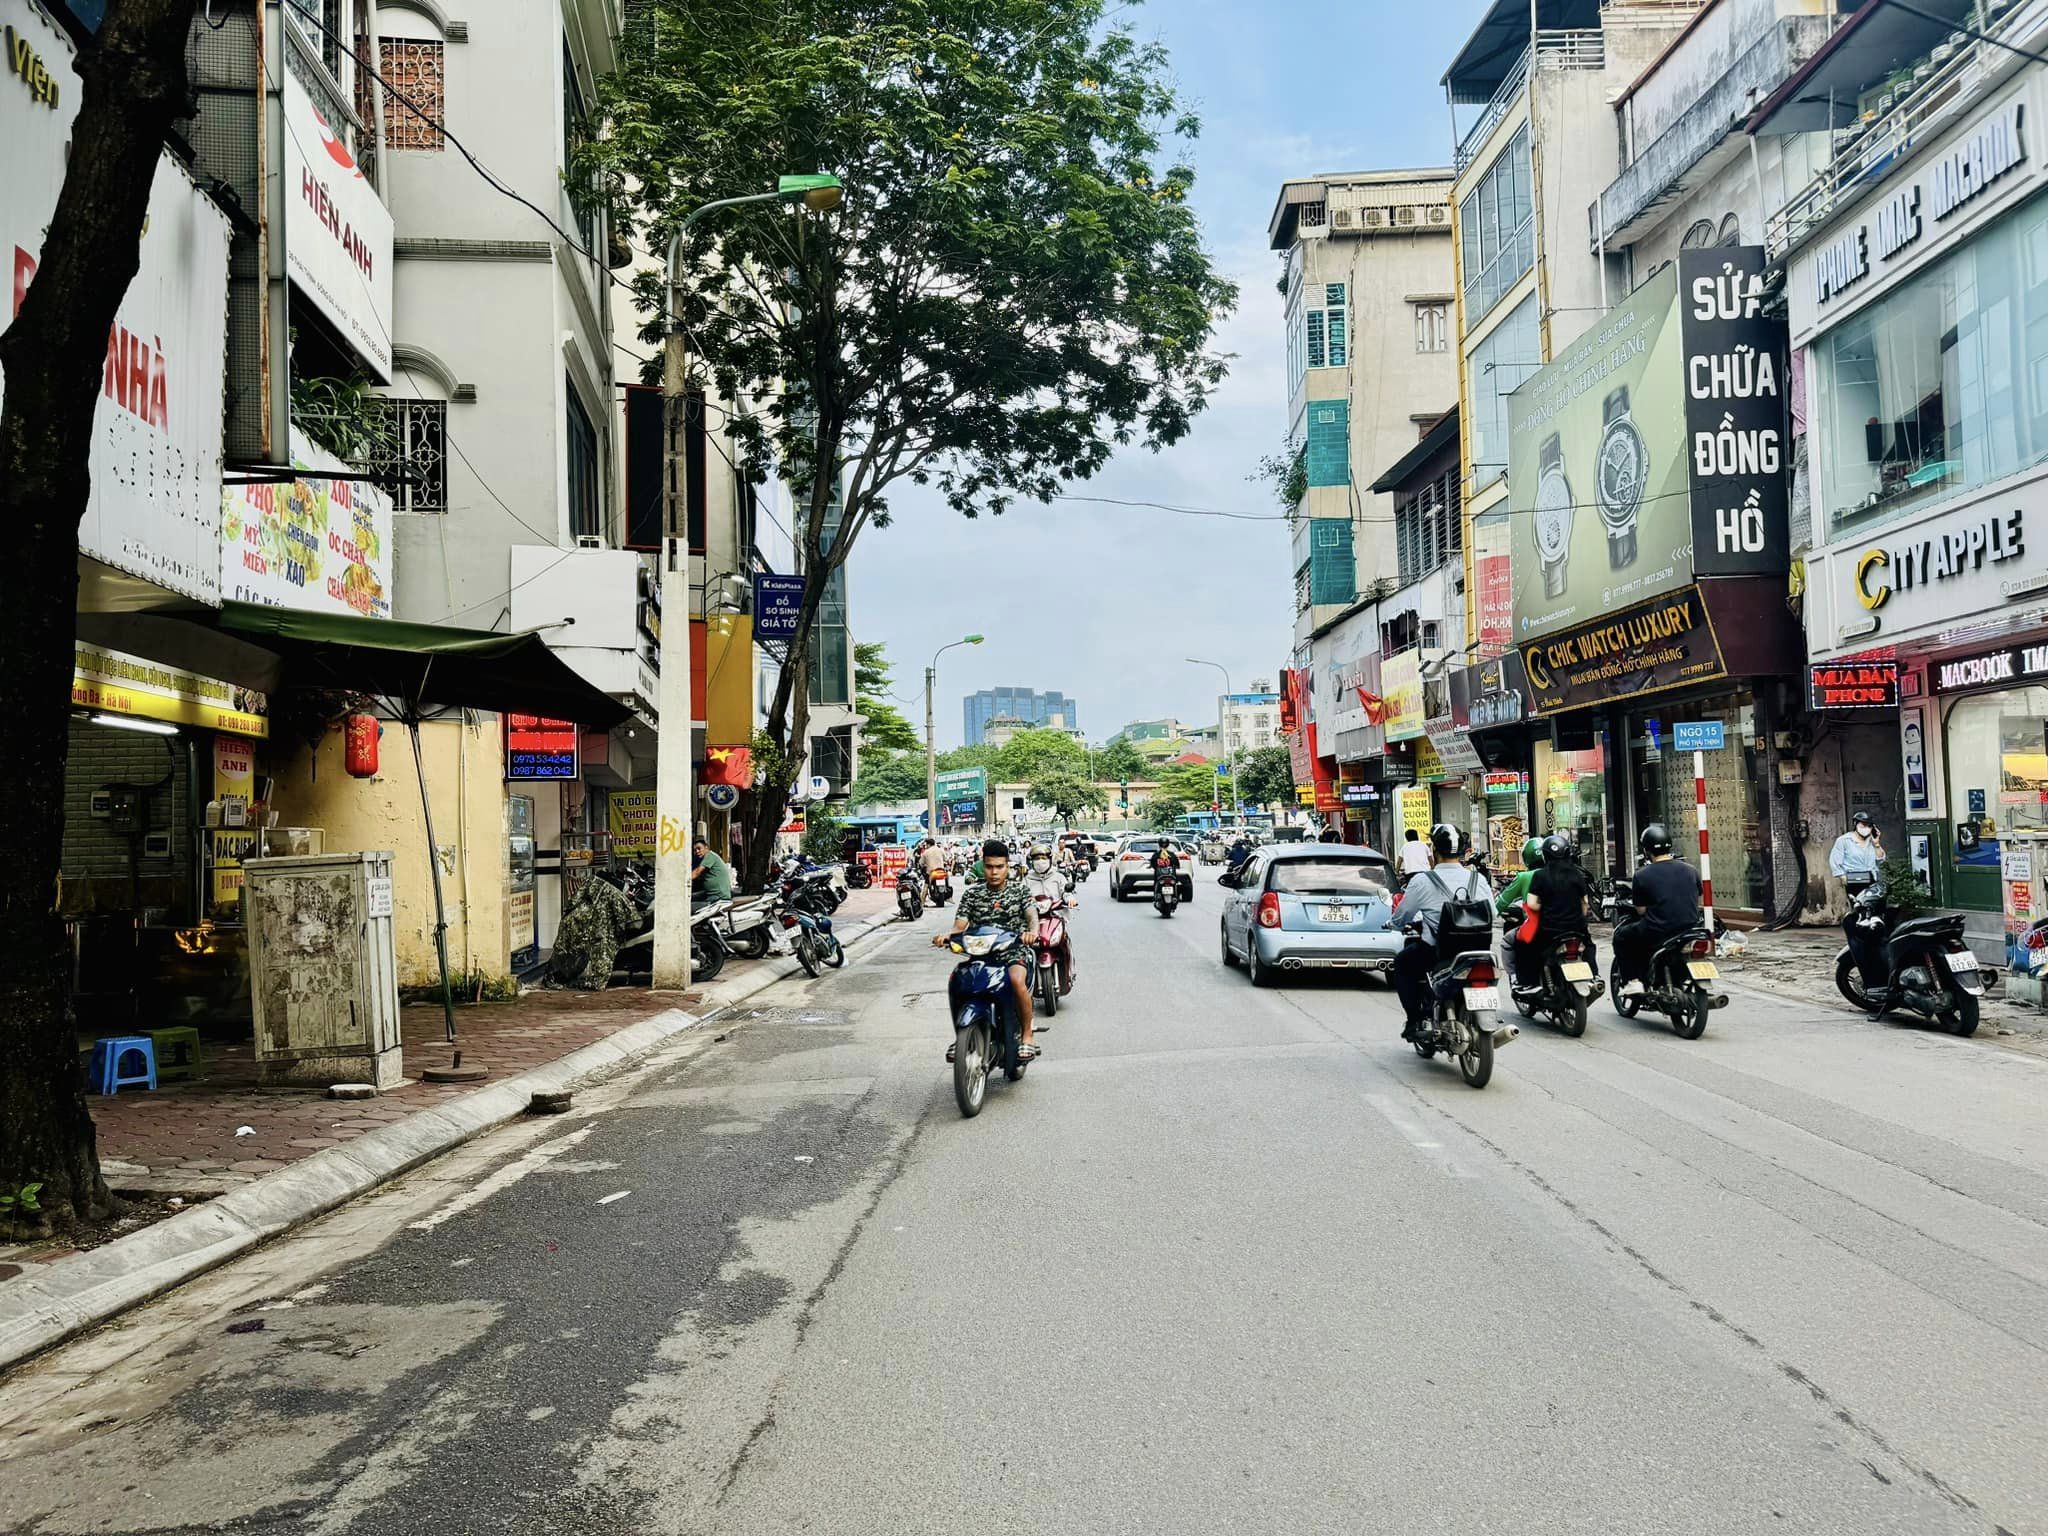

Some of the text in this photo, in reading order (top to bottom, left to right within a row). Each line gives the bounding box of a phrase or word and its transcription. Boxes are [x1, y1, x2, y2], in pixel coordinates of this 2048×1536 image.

[1877, 185, 1922, 262] IMAC
[1932, 104, 2028, 222] MACBOOK
[343, 221, 373, 283] ANH
[1692, 262, 1767, 321] SỬA
[104, 319, 169, 436] NHÀ
[1688, 343, 1777, 399] CHỮA
[1694, 411, 1780, 476] ĐỒNG
[1715, 488, 1765, 553] HỒ
[1935, 509, 2025, 579] APPLE
[760, 615, 799, 628] GIÁ TỐ
[765, 606, 800, 615] SƠ SINH
[1547, 601, 1694, 670] CHIC WATCH LUXURY
[1570, 671, 1587, 686] MUA
[1814, 669, 1859, 687] MUA
[1941, 653, 2014, 689] MACBOOK
[72, 683, 88, 702] ống
[1824, 688, 1886, 704] IPHONE
[1705, 727, 1717, 736] 15
[221, 760, 248, 772] ANH
[623, 809, 654, 819] PHOTO
[621, 824, 632, 833] IN
